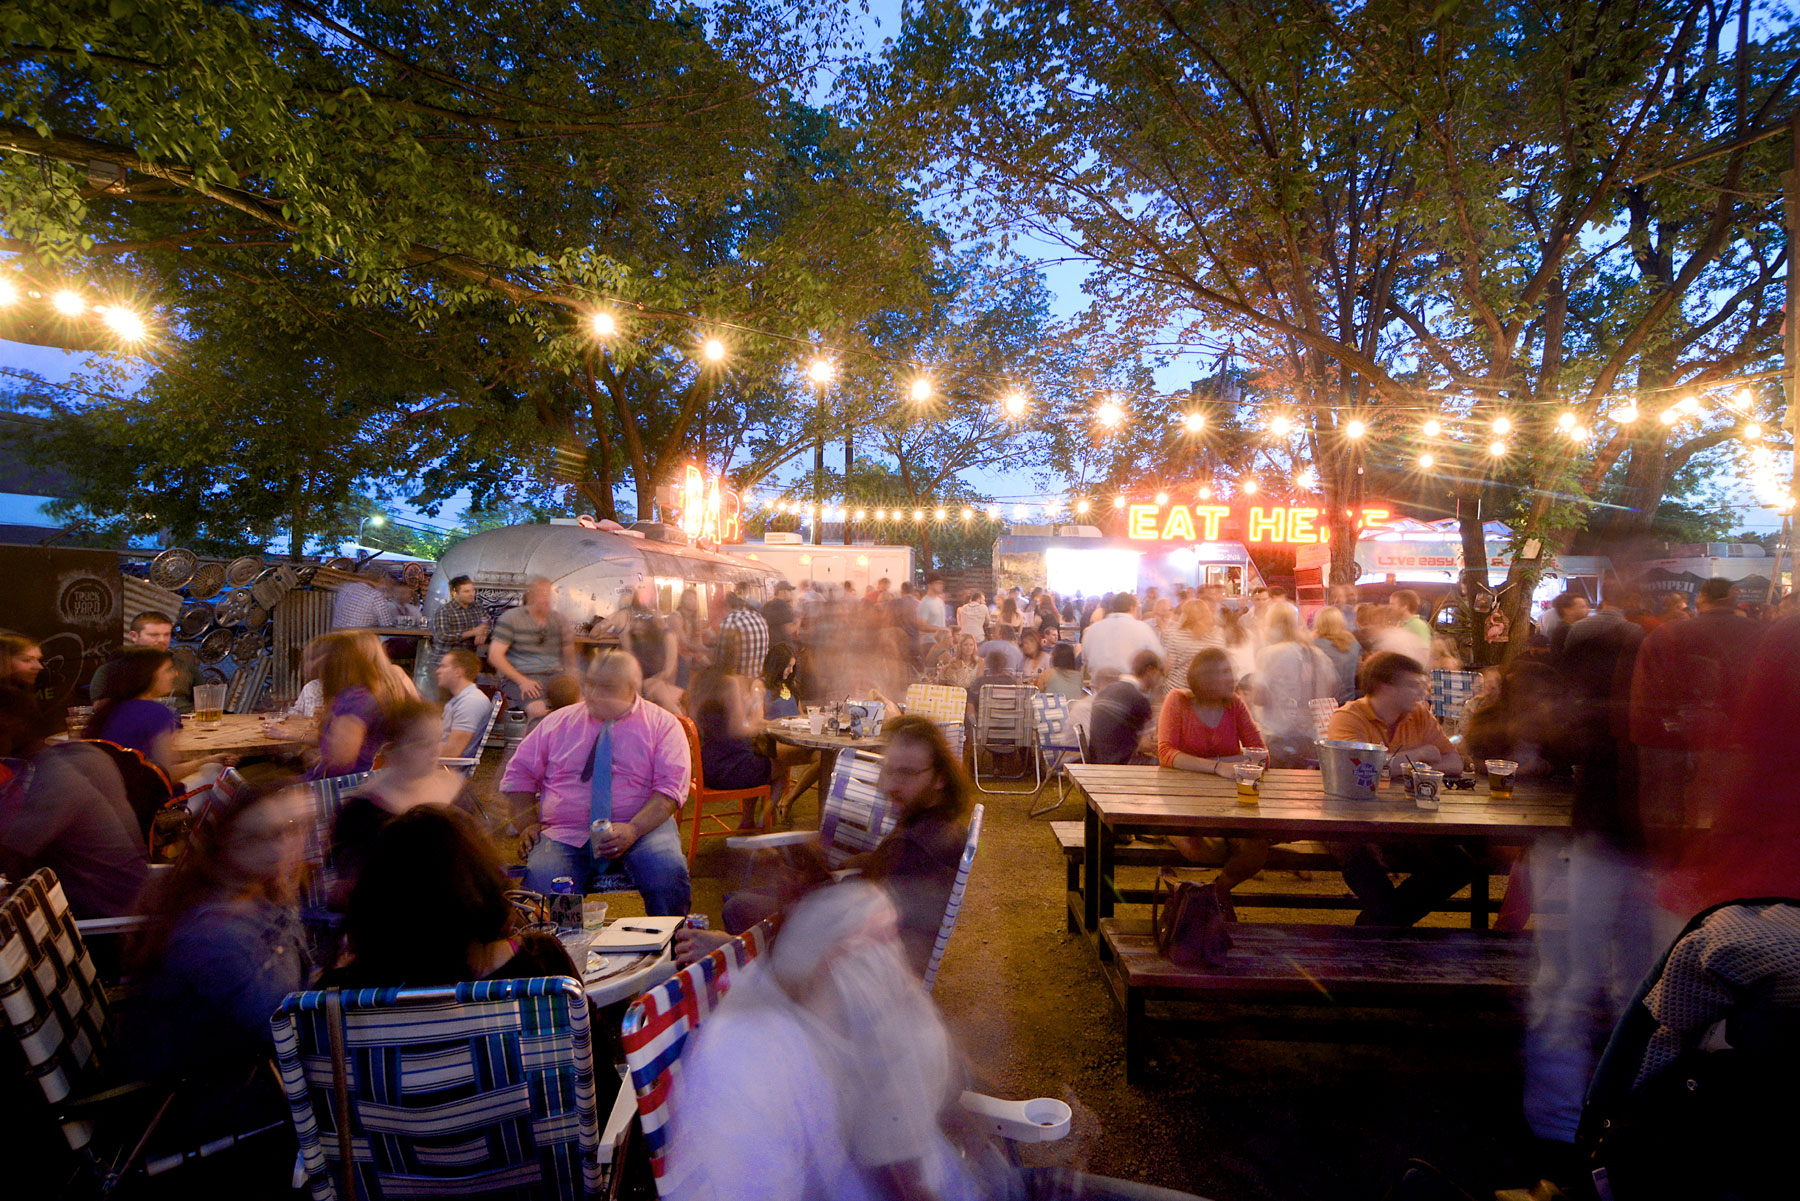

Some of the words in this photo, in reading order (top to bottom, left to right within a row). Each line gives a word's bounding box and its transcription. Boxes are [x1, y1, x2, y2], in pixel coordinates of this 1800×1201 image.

[1129, 505, 1230, 540] EAT
[1249, 506, 1389, 543] HEE
[74, 591, 100, 601] TRUCK
[74, 601, 101, 614] YARD
